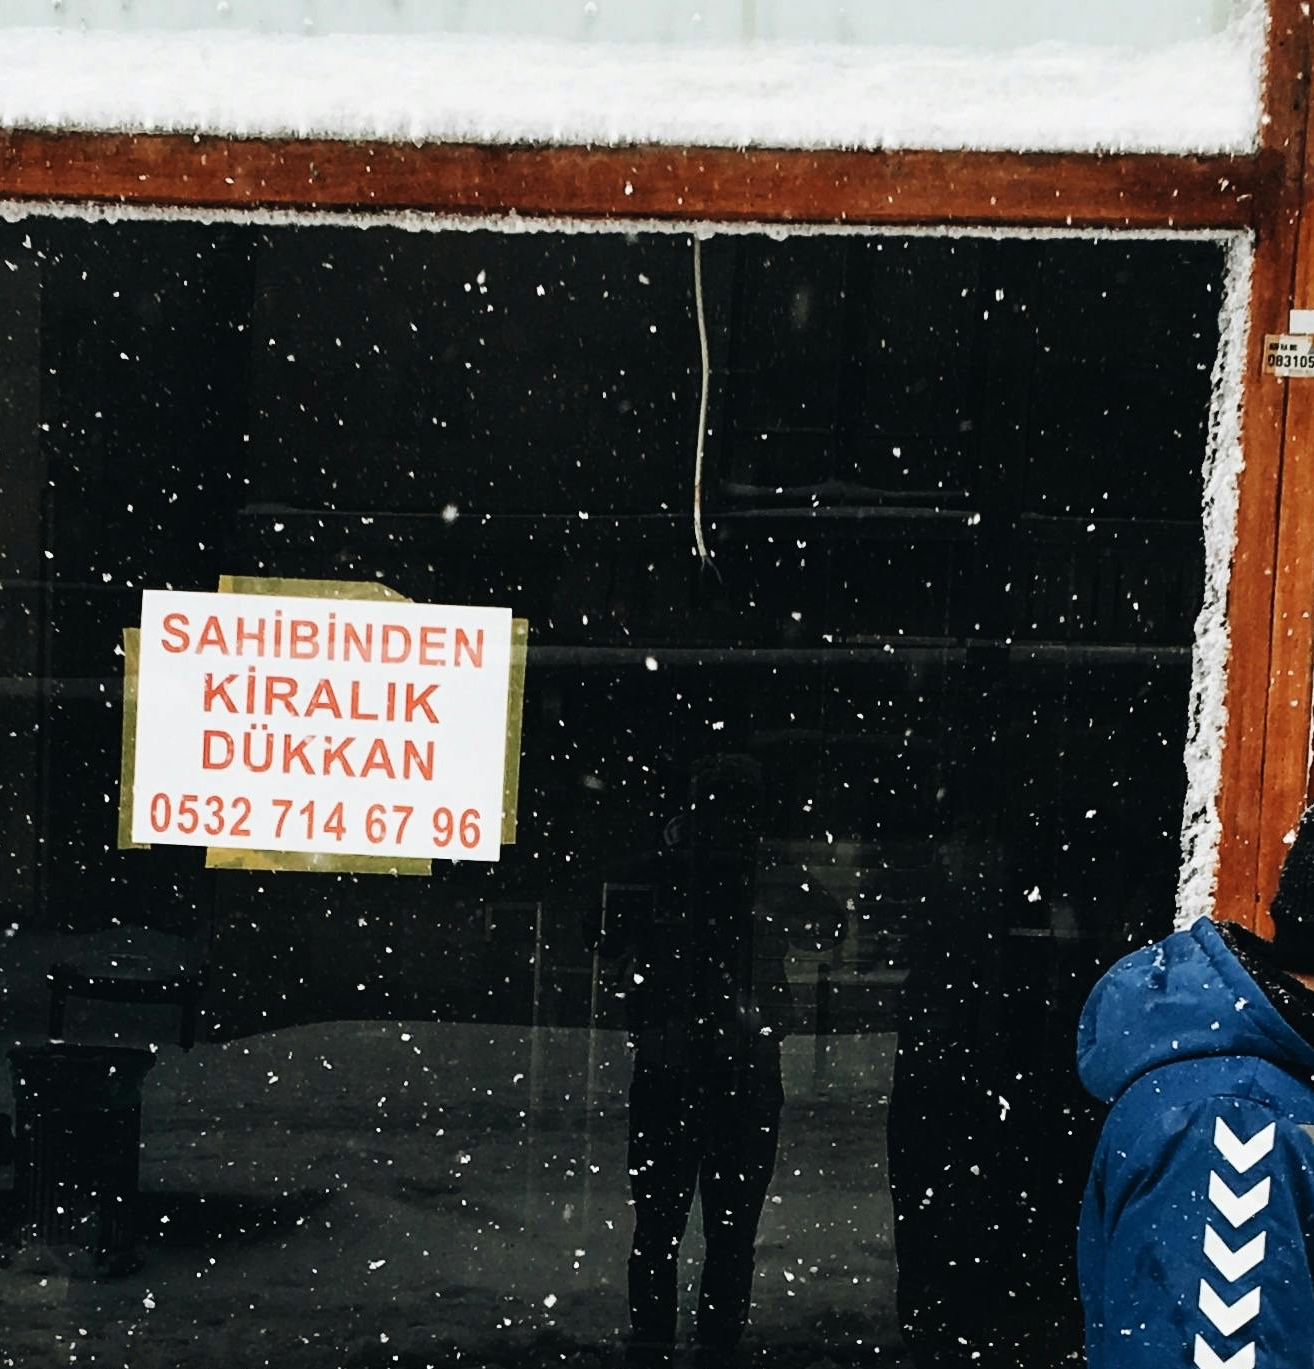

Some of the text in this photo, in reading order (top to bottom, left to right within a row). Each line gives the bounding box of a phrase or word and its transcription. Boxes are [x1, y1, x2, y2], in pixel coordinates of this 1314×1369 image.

[161, 609, 484, 669] SAHİBİNDEN
[203, 665, 441, 724] KİRALIK
[202, 723, 435, 781] DÜKKAN
[150, 792, 481, 849] 0532 714 67 96
